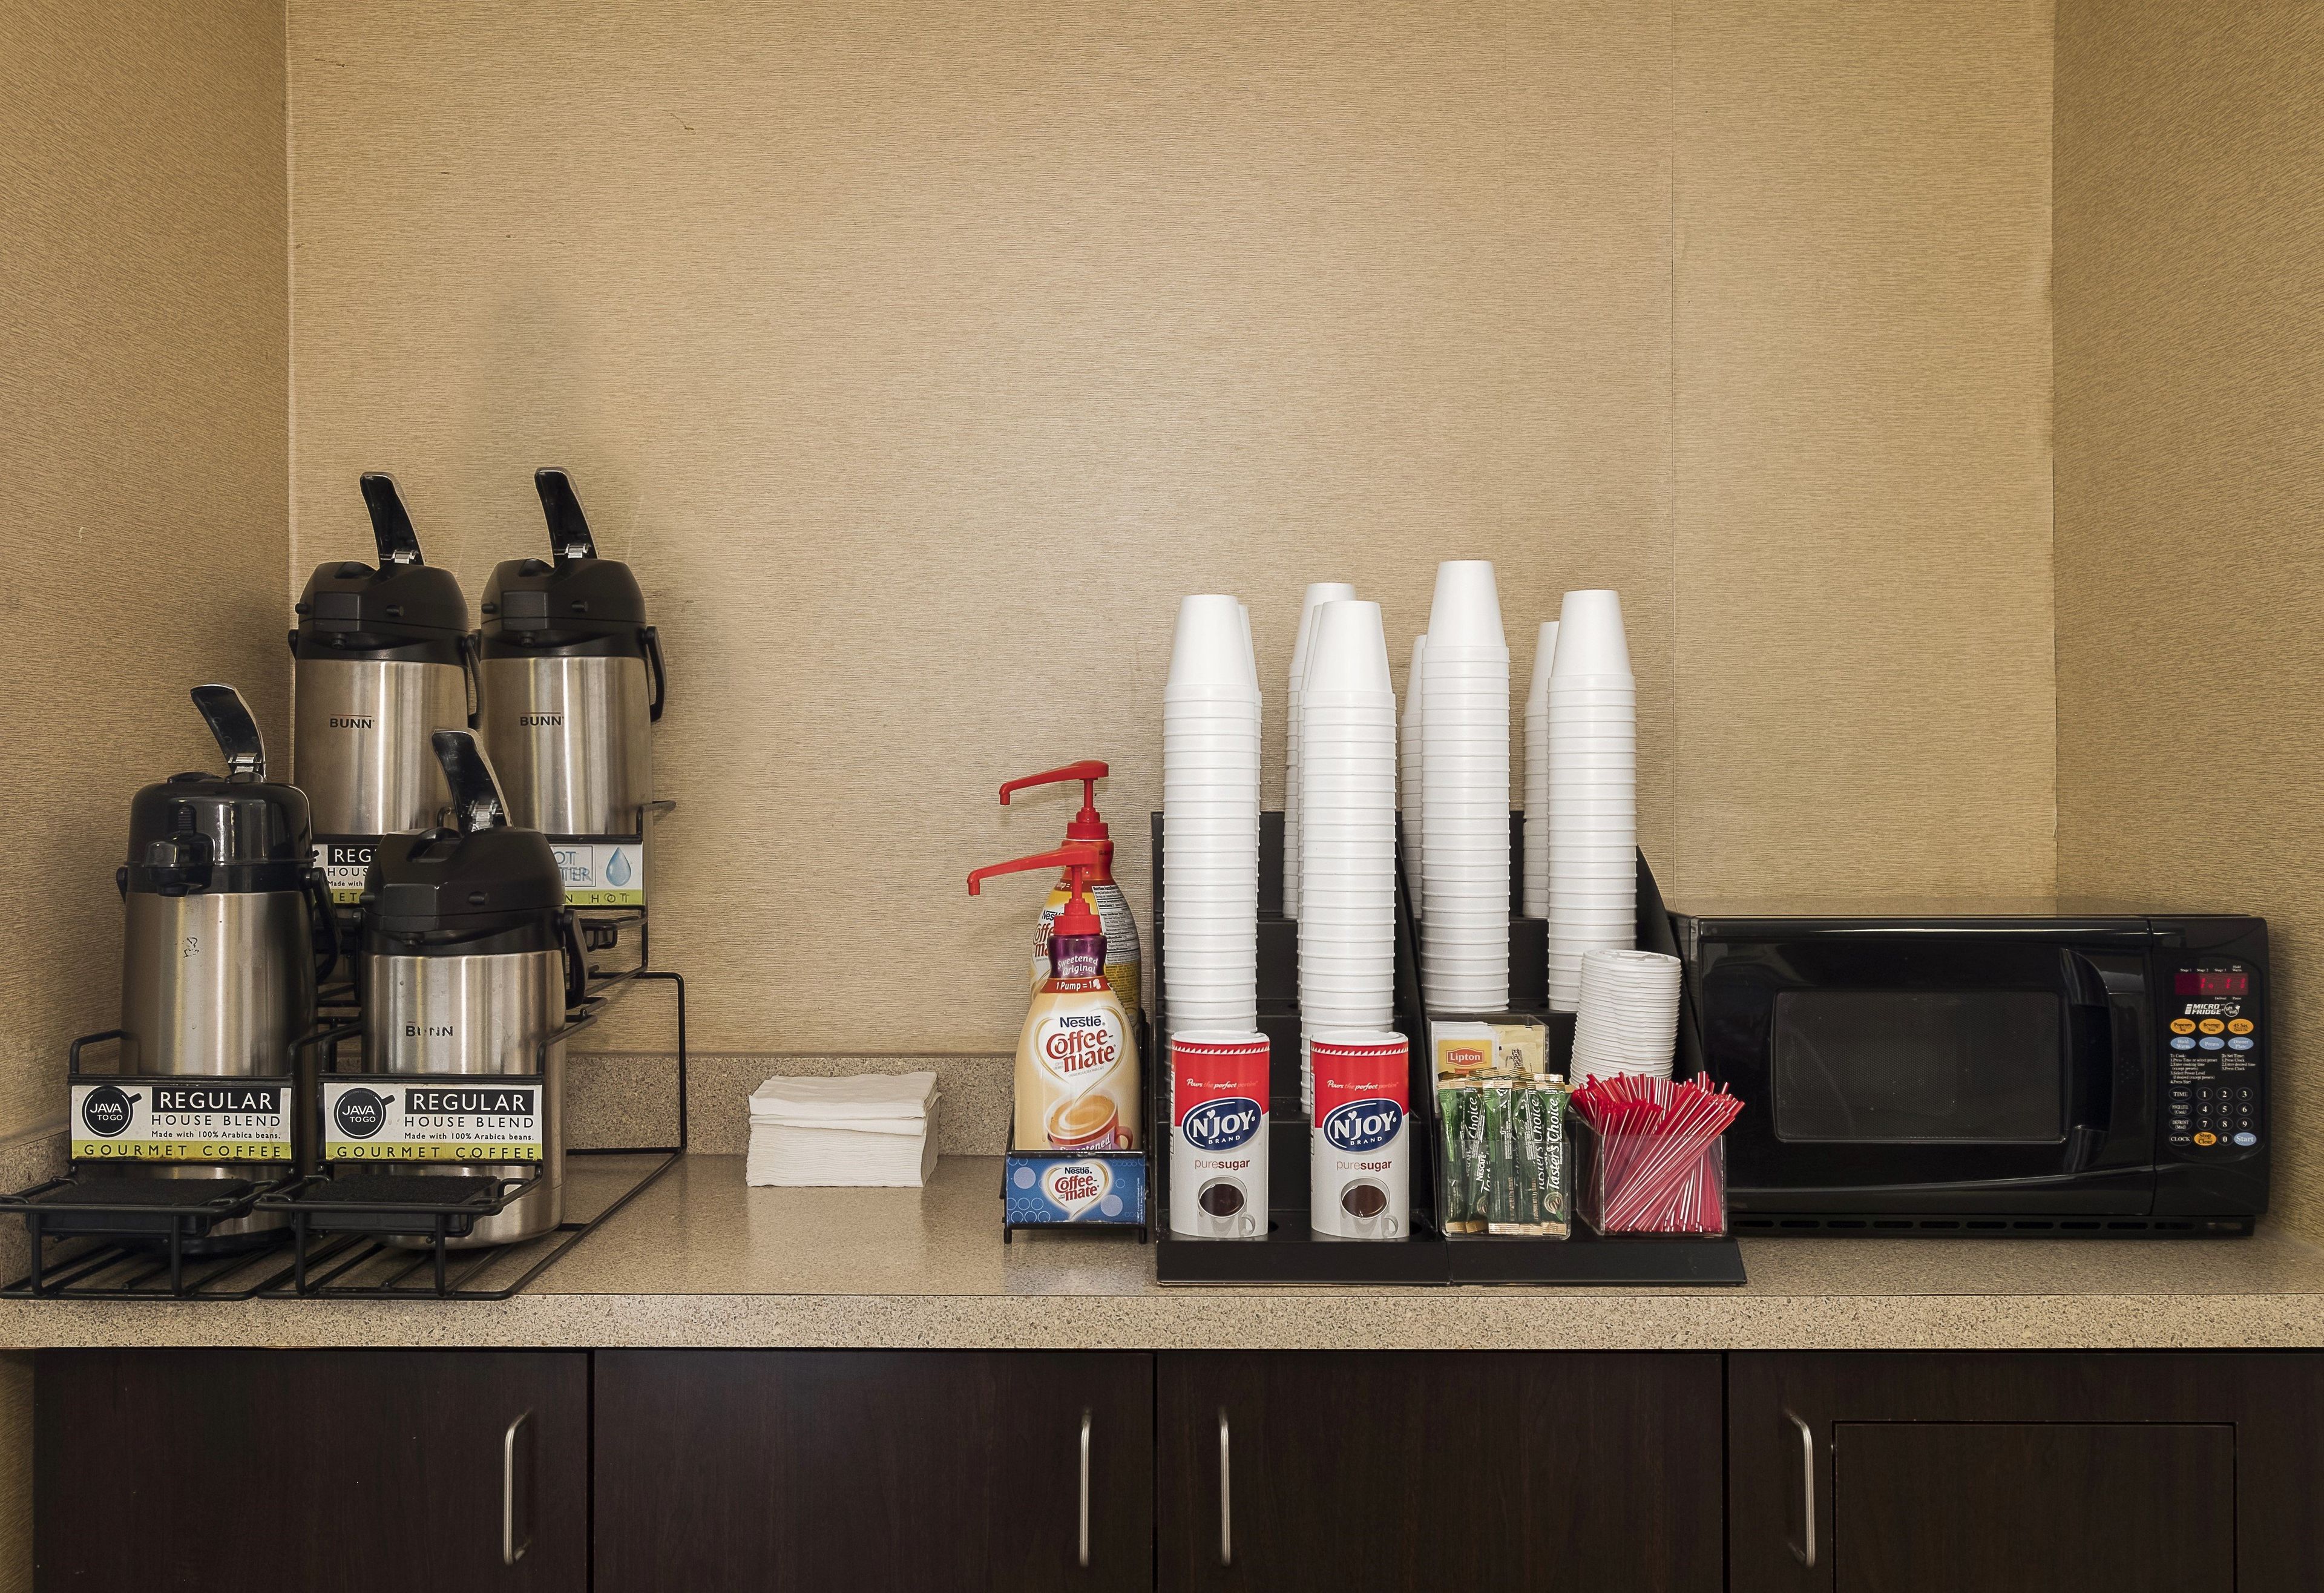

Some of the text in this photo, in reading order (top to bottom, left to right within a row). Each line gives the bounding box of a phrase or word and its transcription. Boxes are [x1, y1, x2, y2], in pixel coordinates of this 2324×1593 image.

[330, 718, 372, 729] BUNN
[520, 716, 561, 726] BUNN
[554, 851, 576, 865] OT
[328, 867, 368, 876] HOUS
[1033, 923, 1054, 945] Coffe
[1058, 956, 1098, 970] Sweetened
[1062, 964, 1096, 976] Original
[1056, 982, 1060, 990] 1
[1060, 981, 1081, 991] Pump
[1063, 1046, 1115, 1072] mate
[1449, 1053, 1481, 1063] Lipton
[1186, 1078, 1203, 1087] Pours
[1213, 1080, 1237, 1089] perfect
[1327, 1080, 1344, 1089] Pours
[1355, 1082, 1378, 1091] perfect
[160, 1092, 272, 1109] REGULAR
[413, 1094, 525, 1111] REGULAR
[90, 1103, 122, 1113] JAVA
[342, 1105, 375, 1115] JAVA
[152, 1114, 280, 1126] HOUSE BLEND
[404, 1117, 533, 1128] HOUSE BLEND
[1209, 1135, 1241, 1144] BRAND
[1350, 1136, 1382, 1145] BRAND
[84, 1145, 280, 1157] GOURMET COFFEE
[337, 1146, 533, 1158] GOURMET COFFEE
[1066, 1186, 1098, 1201] mate
